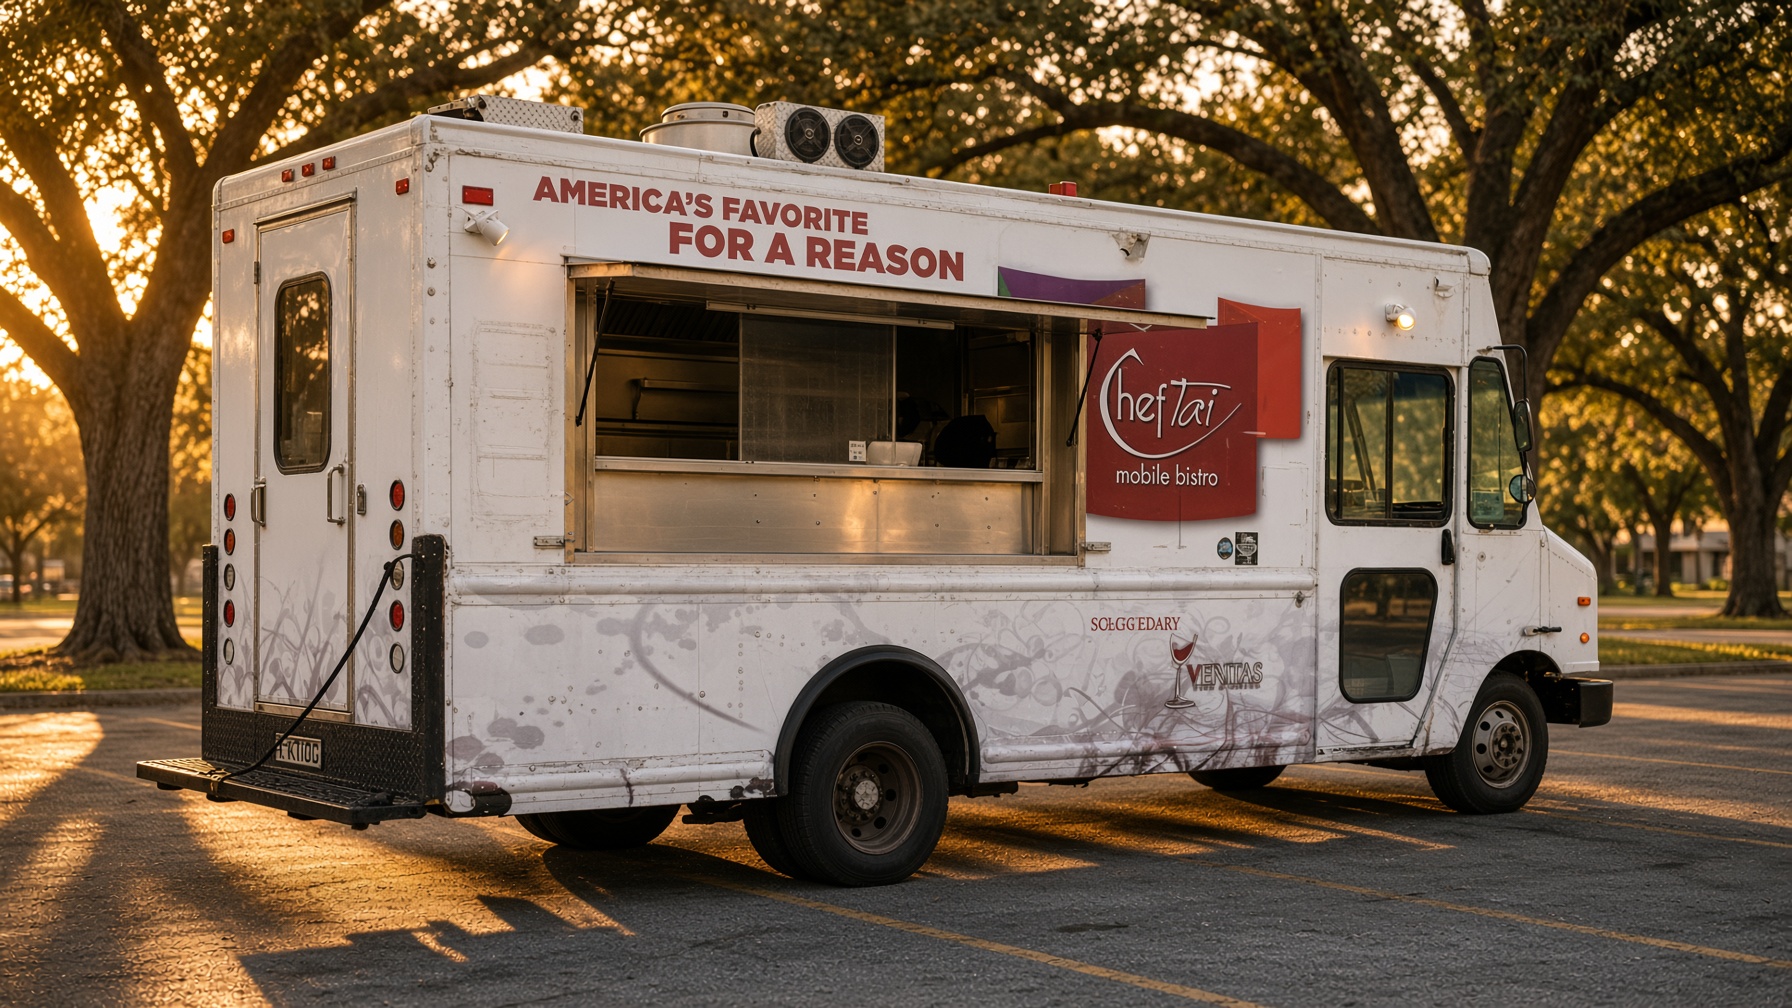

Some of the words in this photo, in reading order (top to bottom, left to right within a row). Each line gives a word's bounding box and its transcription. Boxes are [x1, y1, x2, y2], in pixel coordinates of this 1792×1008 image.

[533, 176, 714, 219] AMERICA'S
[722, 196, 869, 236] FAVORITE
[669, 221, 754, 261] FOR
[765, 232, 796, 266] A
[806, 236, 965, 282] REASON
[1171, 378, 1231, 427] Tai
[1116, 463, 1170, 486] mobile
[1175, 464, 1219, 487] bistro
